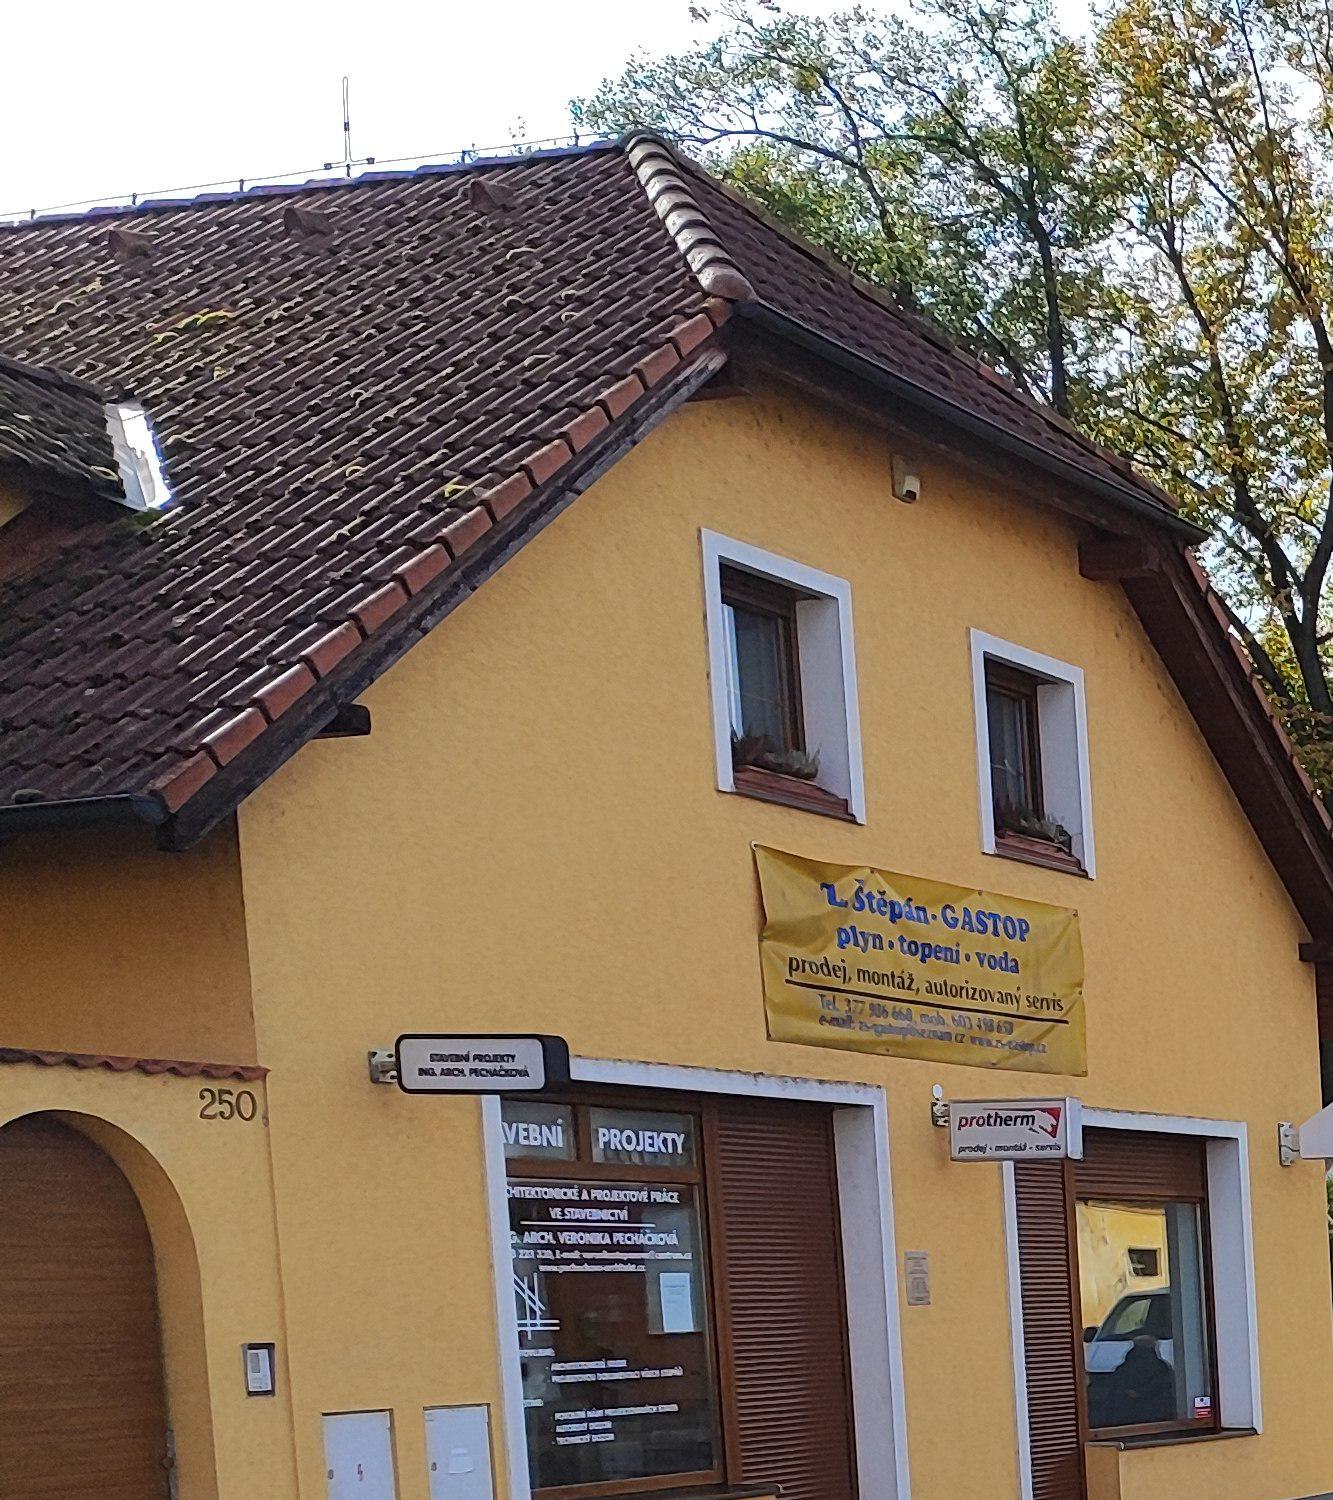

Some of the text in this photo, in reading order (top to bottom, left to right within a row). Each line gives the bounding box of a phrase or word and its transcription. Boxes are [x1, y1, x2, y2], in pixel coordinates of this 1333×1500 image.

[852, 879, 930, 925] Štěpán
[940, 904, 1030, 942] GASTOP
[836, 925, 884, 953] plyn
[975, 950, 1020, 974] voda
[788, 956, 852, 984] prodej,
[925, 978, 1021, 1011] autorizovaný
[1025, 992, 1064, 1012] servis
[472, 1053, 516, 1063] PROJEKTY
[199, 1088, 257, 1121] 250
[957, 1112, 1036, 1131] protherm
[598, 1127, 685, 1154] PROJEKTY
[958, 1143, 988, 1154] prodej
[581, 1189, 590, 1200] A
